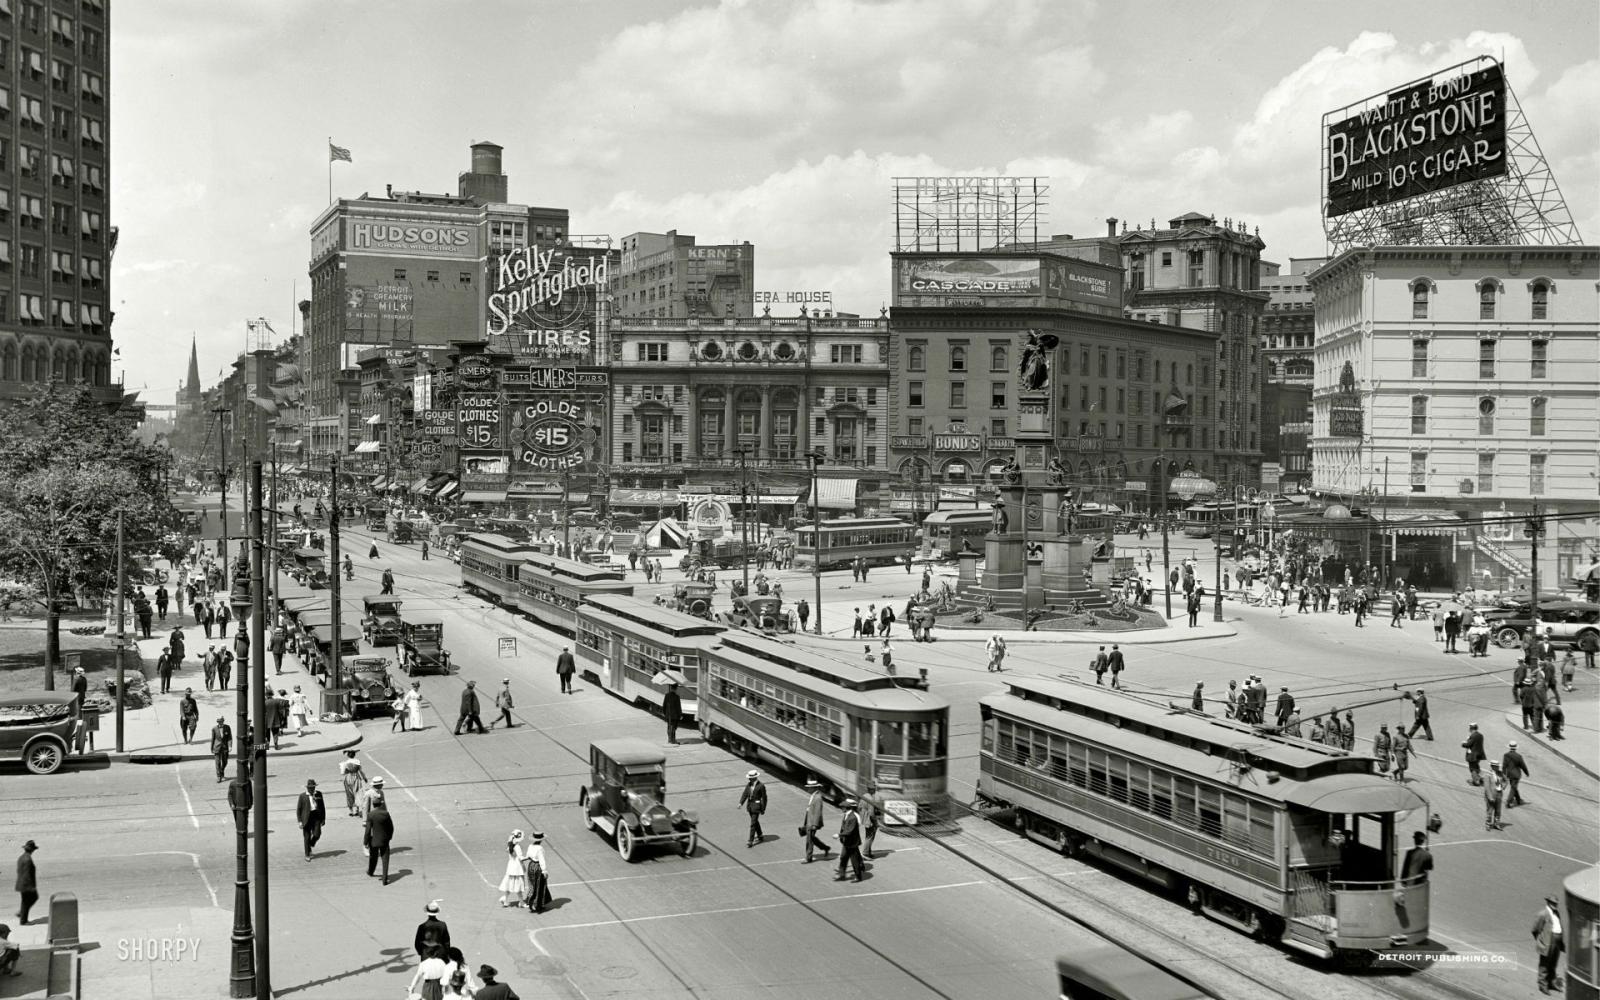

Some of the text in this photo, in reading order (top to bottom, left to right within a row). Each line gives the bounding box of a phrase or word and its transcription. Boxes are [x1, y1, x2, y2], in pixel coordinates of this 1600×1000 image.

[1360, 74, 1472, 127] WAITT & BOND
[1329, 91, 1496, 182] BLACKSTONE
[1351, 172, 1382, 192] MILD
[1423, 140, 1502, 179] CIGAR
[353, 223, 471, 248] HUDSON'S
[688, 248, 743, 258] KERN'S
[912, 281, 1010, 291] CASCADE
[487, 255, 607, 335] Springfield
[786, 291, 831, 303] HOUSE
[378, 301, 407, 312] MILK
[523, 330, 591, 345] TIRES
[504, 373, 529, 381] SUITS
[531, 367, 575, 389] ELMER'S
[463, 398, 493, 407] GOLDE
[525, 400, 581, 419] GOLDE
[424, 411, 455, 420] GOLDE
[459, 410, 499, 423] CLOTHES
[424, 426, 455, 435] CLOTHES
[466, 425, 491, 443] $15
[535, 427, 569, 446] $15
[936, 435, 979, 450] BOND'S
[523, 450, 584, 469] CLOTHES
